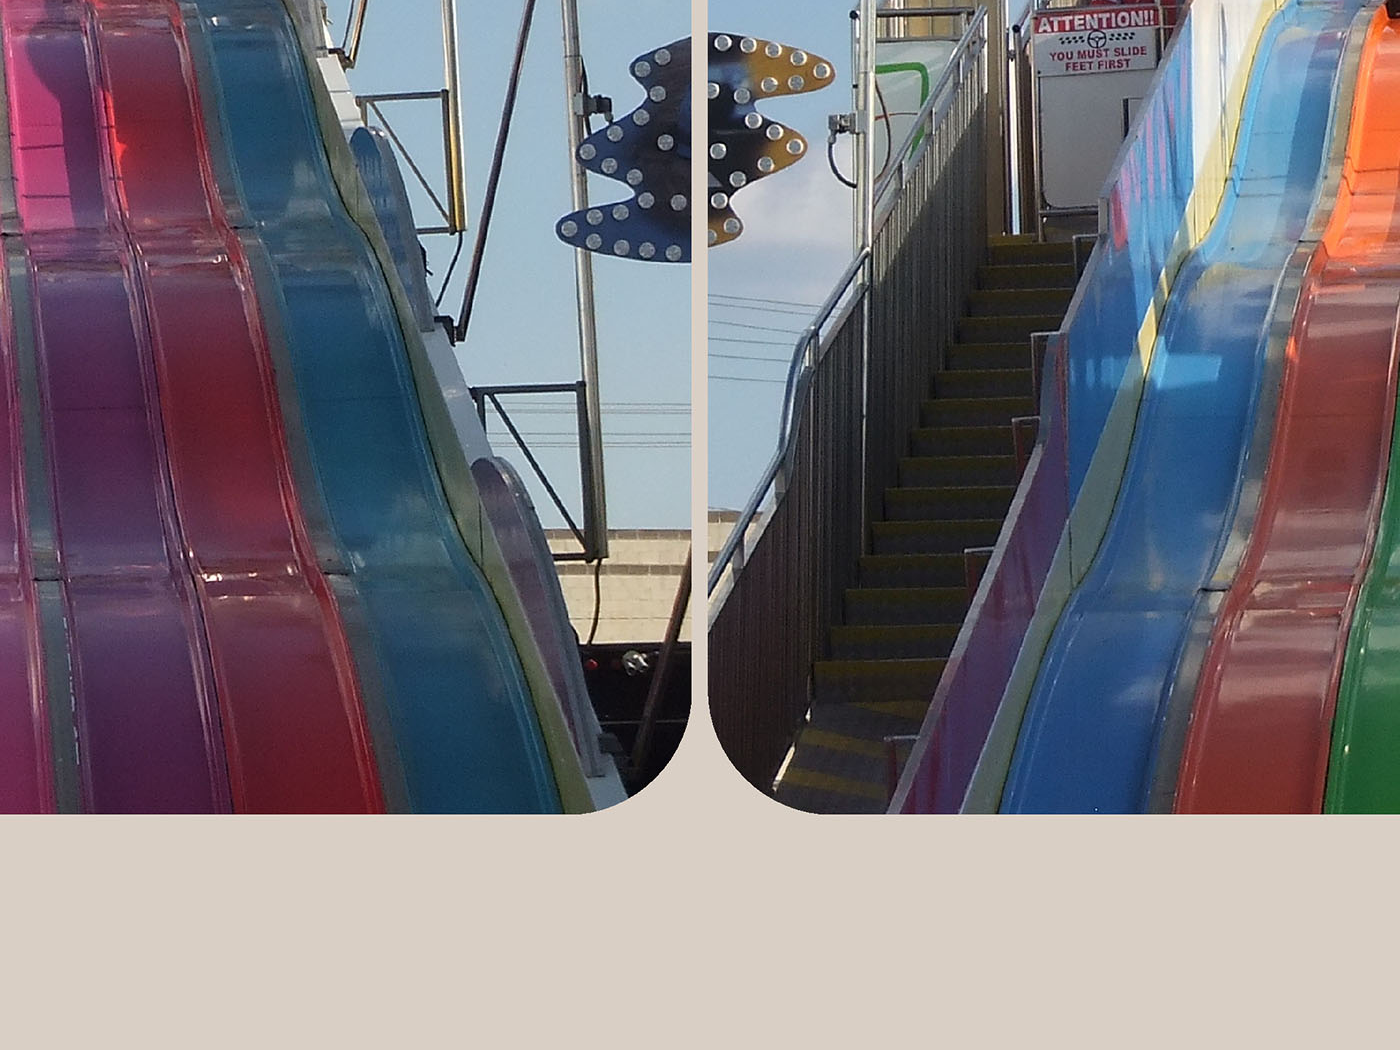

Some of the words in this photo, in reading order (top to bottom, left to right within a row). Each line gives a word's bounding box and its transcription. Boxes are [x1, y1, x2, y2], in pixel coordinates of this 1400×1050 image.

[1038, 10, 1154, 33] ATTENTION!!
[1050, 52, 1073, 61] YOU
[1077, 48, 1109, 60] MUST
[1114, 46, 1147, 57] SLIDE
[1065, 62, 1094, 72] FEET
[1098, 58, 1131, 70] FIRST
